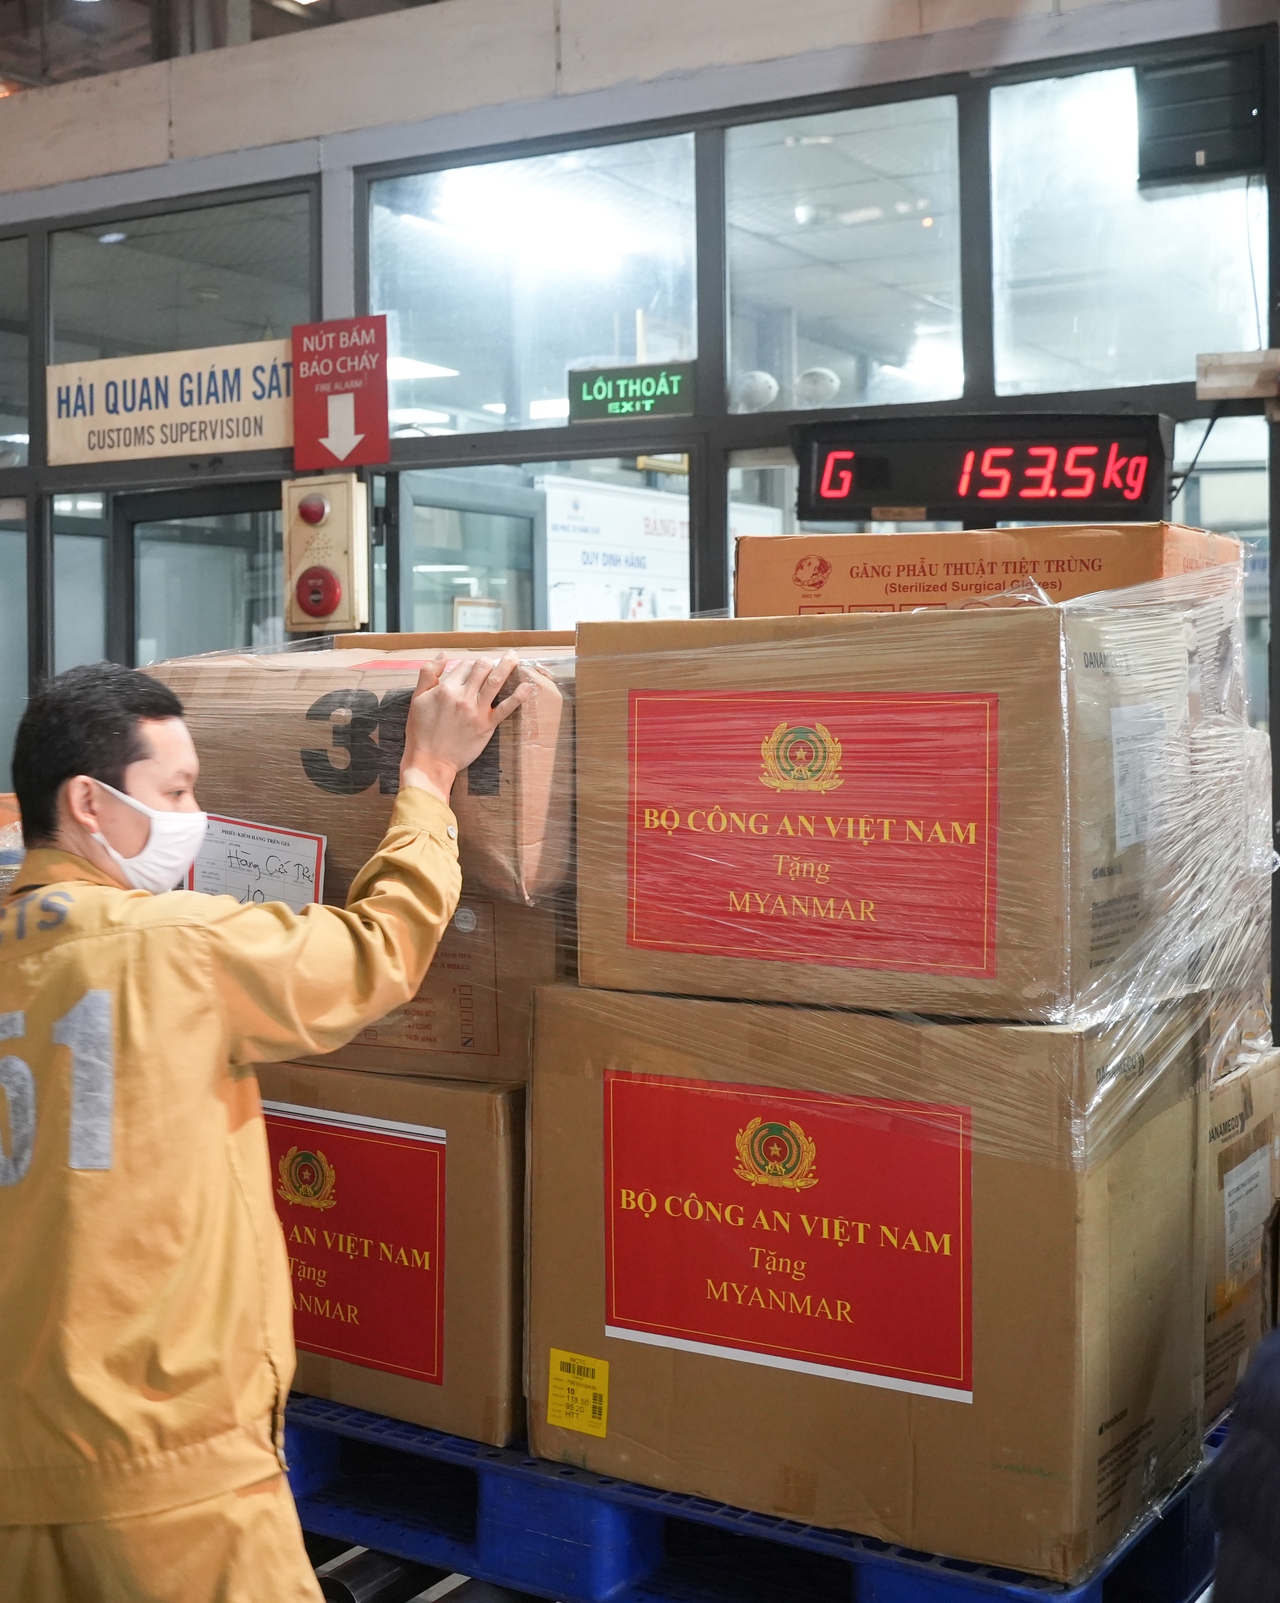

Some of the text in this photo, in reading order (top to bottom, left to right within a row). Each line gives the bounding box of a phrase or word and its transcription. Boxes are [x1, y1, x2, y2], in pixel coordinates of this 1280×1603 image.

[302, 324, 376, 352] NÚT BẤM
[299, 349, 380, 378] BÁO CHÁY
[56, 357, 293, 418] HẢI QUAN GIÁM SÁT
[315, 379, 363, 393] FIRE ALARM
[582, 371, 682, 400] LỐI THOÁT
[608, 400, 655, 413] EXIT
[87, 416, 264, 451] CUSTOMS SUPERVISION
[820, 451, 855, 498] G
[849, 555, 1103, 580] GĂNG PHẪU THUẬT TIỆT TRÙNG
[884, 582, 948, 596] (Sterilized
[951, 580, 1006, 594] Surgical
[643, 805, 978, 846] BỘ CÔNG AN VIỆT NAM
[773, 853, 831, 884] Tặng
[728, 891, 878, 922] MYANMAR
[620, 1188, 952, 1256] BỘ CÔNG AN VIỆT NAM
[289, 1225, 431, 1271] AN VIỆT NAM
[286, 1257, 328, 1288] Tặng
[749, 1247, 807, 1281] Tặng
[291, 1293, 360, 1325] NMAR
[706, 1279, 854, 1324] MYANMAR
[566, 1387, 575, 1395] 10
